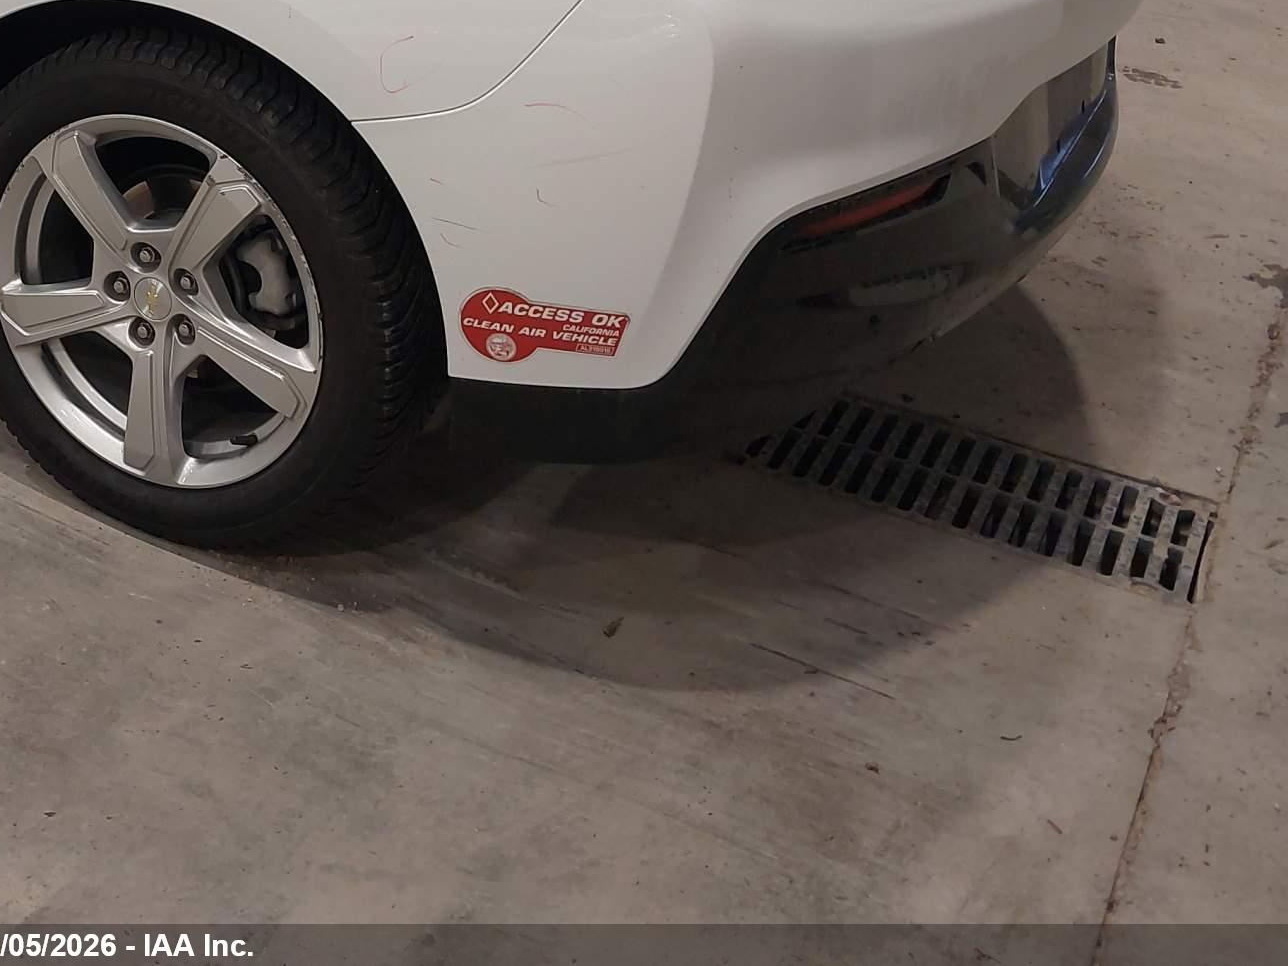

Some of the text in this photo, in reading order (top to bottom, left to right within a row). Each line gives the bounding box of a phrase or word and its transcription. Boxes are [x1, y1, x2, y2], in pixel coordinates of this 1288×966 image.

[498, 301, 626, 328] ACCESS OK
[462, 317, 618, 346] CLEAN AIR VEHICLE
[562, 324, 620, 337] CALIFORNIA
